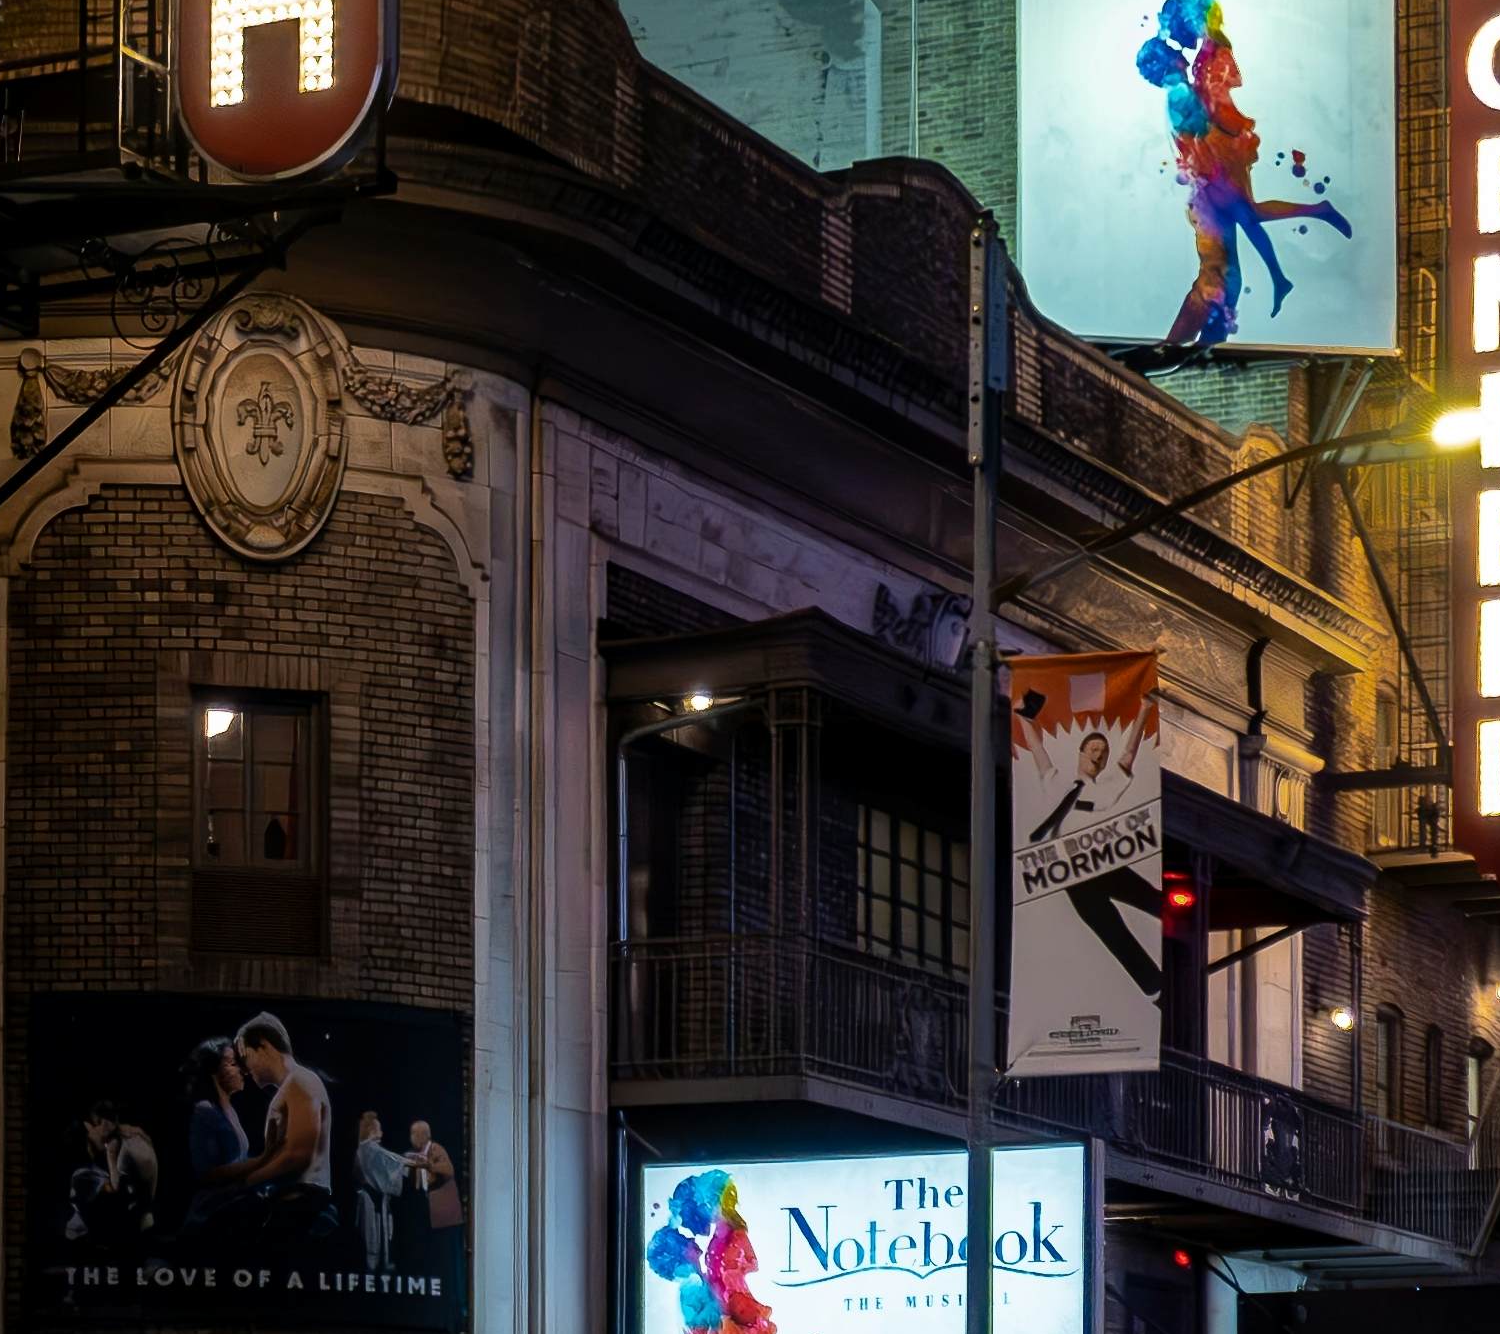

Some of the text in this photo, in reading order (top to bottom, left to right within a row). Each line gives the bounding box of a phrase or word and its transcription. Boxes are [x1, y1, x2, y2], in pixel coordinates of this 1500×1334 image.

[1017, 841, 1058, 870] THE
[1021, 823, 1159, 897] MORMON
[884, 1176, 965, 1211] The
[66, 1267, 443, 1298] THE LOVE OF A LIFETIME
[843, 1293, 1012, 1312] THE MUSIL
